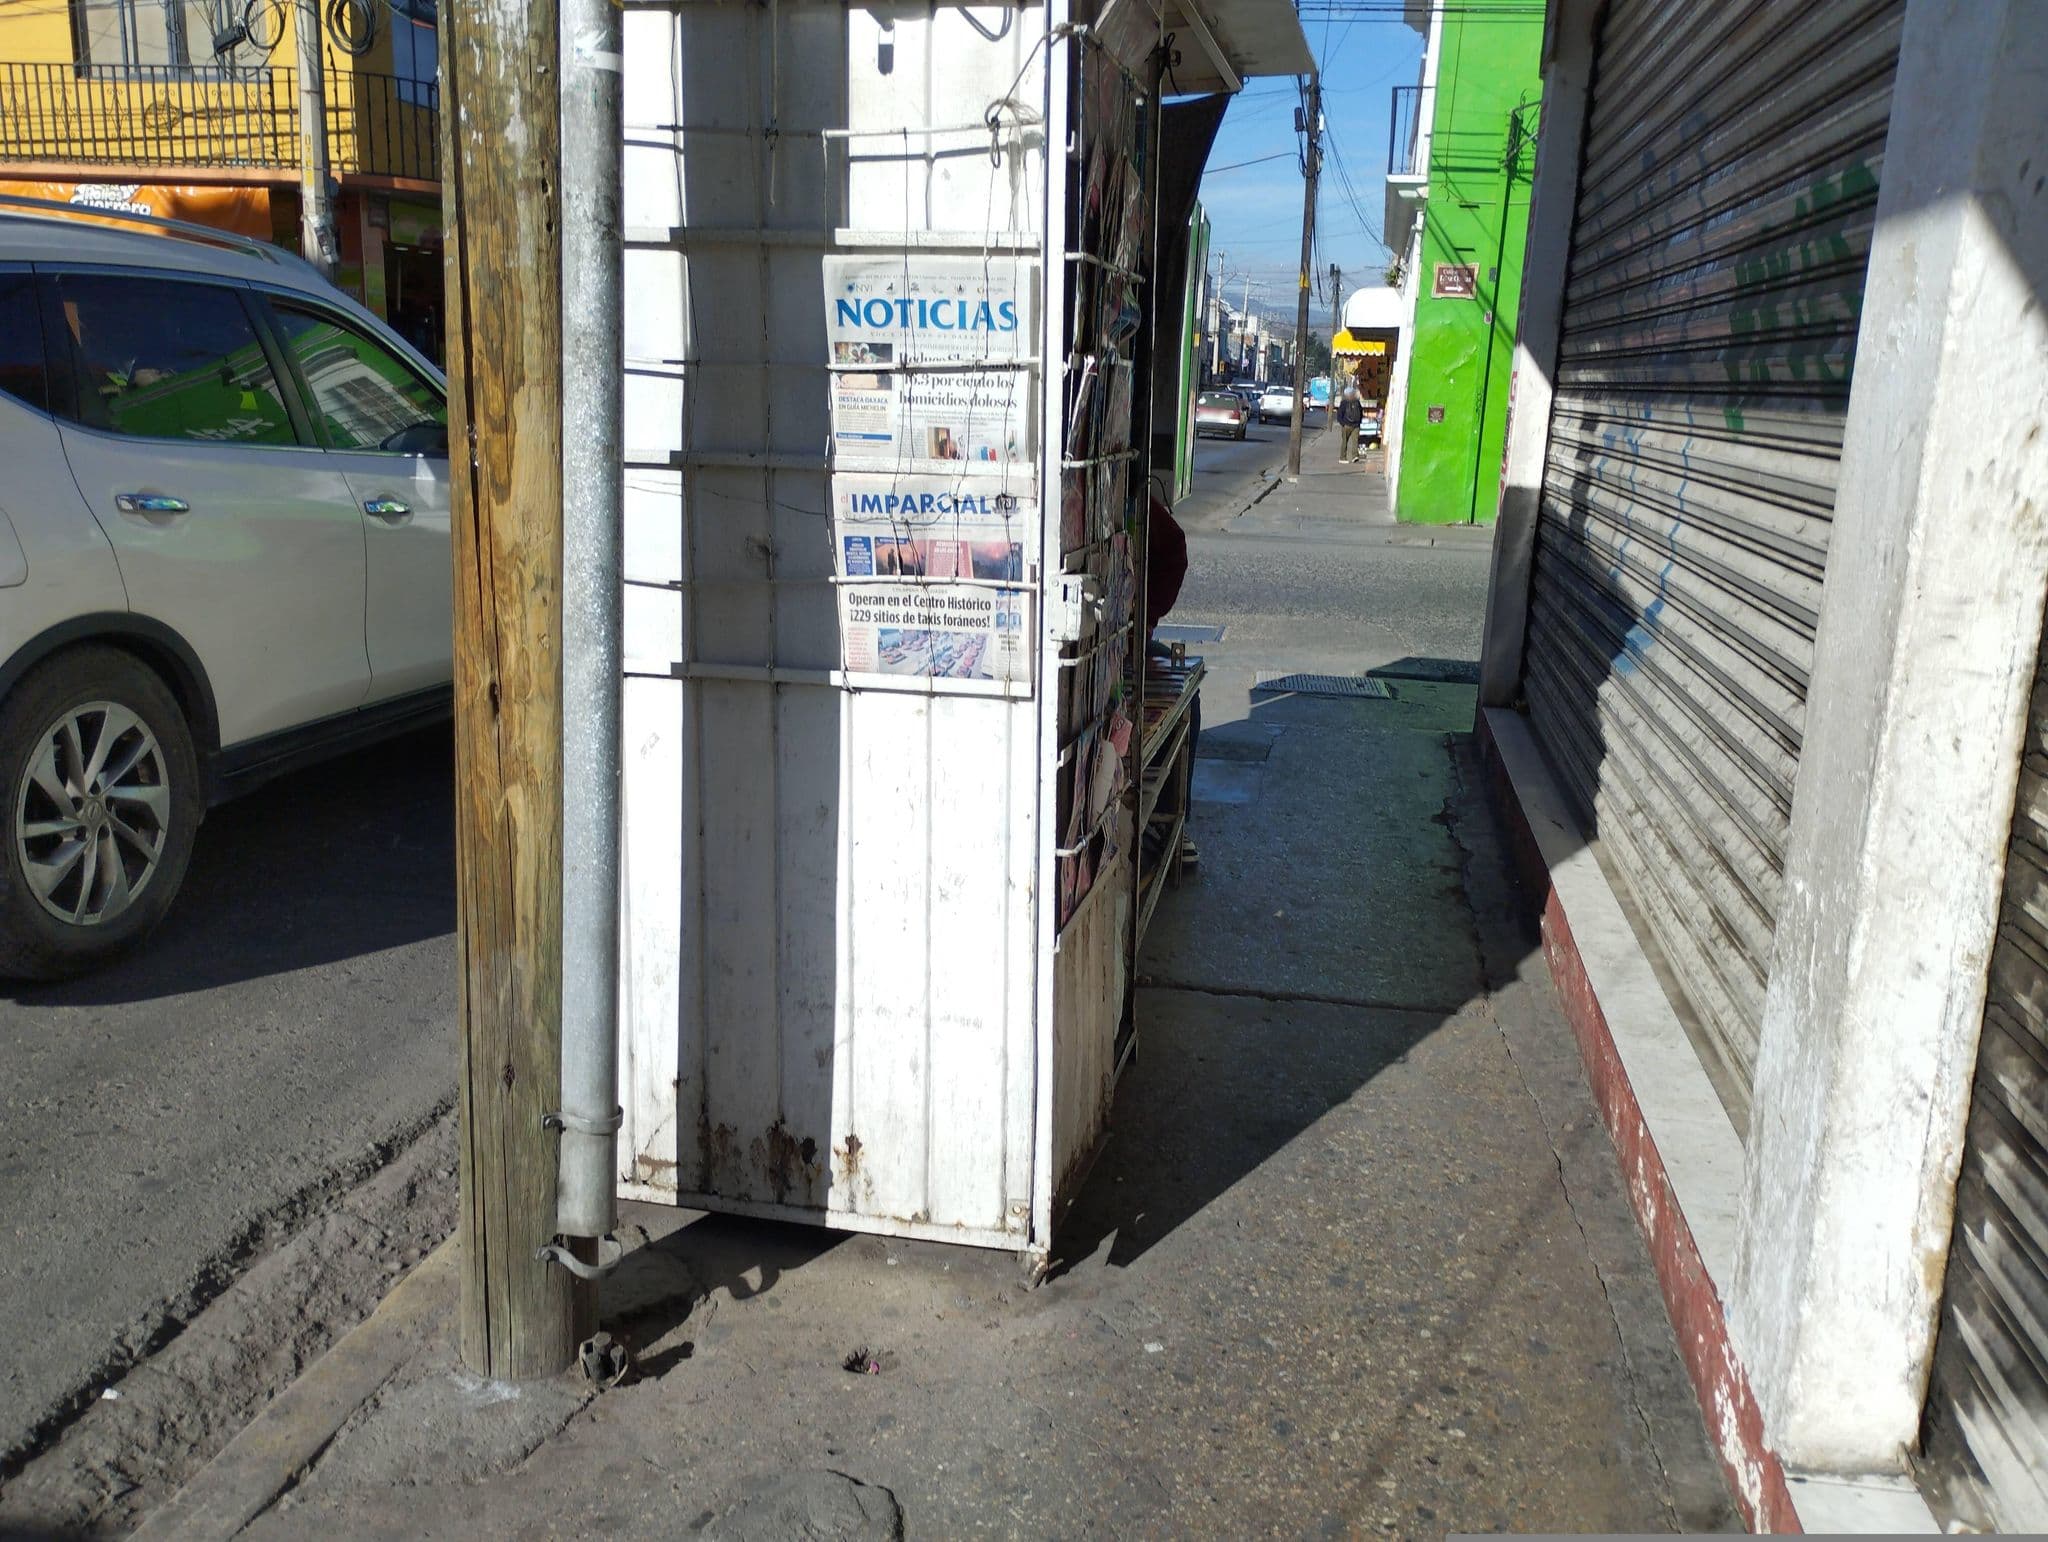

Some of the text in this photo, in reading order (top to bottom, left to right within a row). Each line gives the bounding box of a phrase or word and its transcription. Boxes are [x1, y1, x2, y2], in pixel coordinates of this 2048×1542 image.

[835, 298, 1019, 332] NOTICIAS
[931, 375, 955, 389] por
[997, 374, 1014, 388] los
[899, 390, 1018, 408] homicidios dolosos
[851, 493, 991, 515] IMPARCIAL
[849, 592, 992, 611] Operan en el Centro Histórico
[873, 610, 901, 623] sitios
[903, 611, 916, 624] de
[918, 612, 942, 625] taxis
[943, 613, 991, 628] foráneos!
